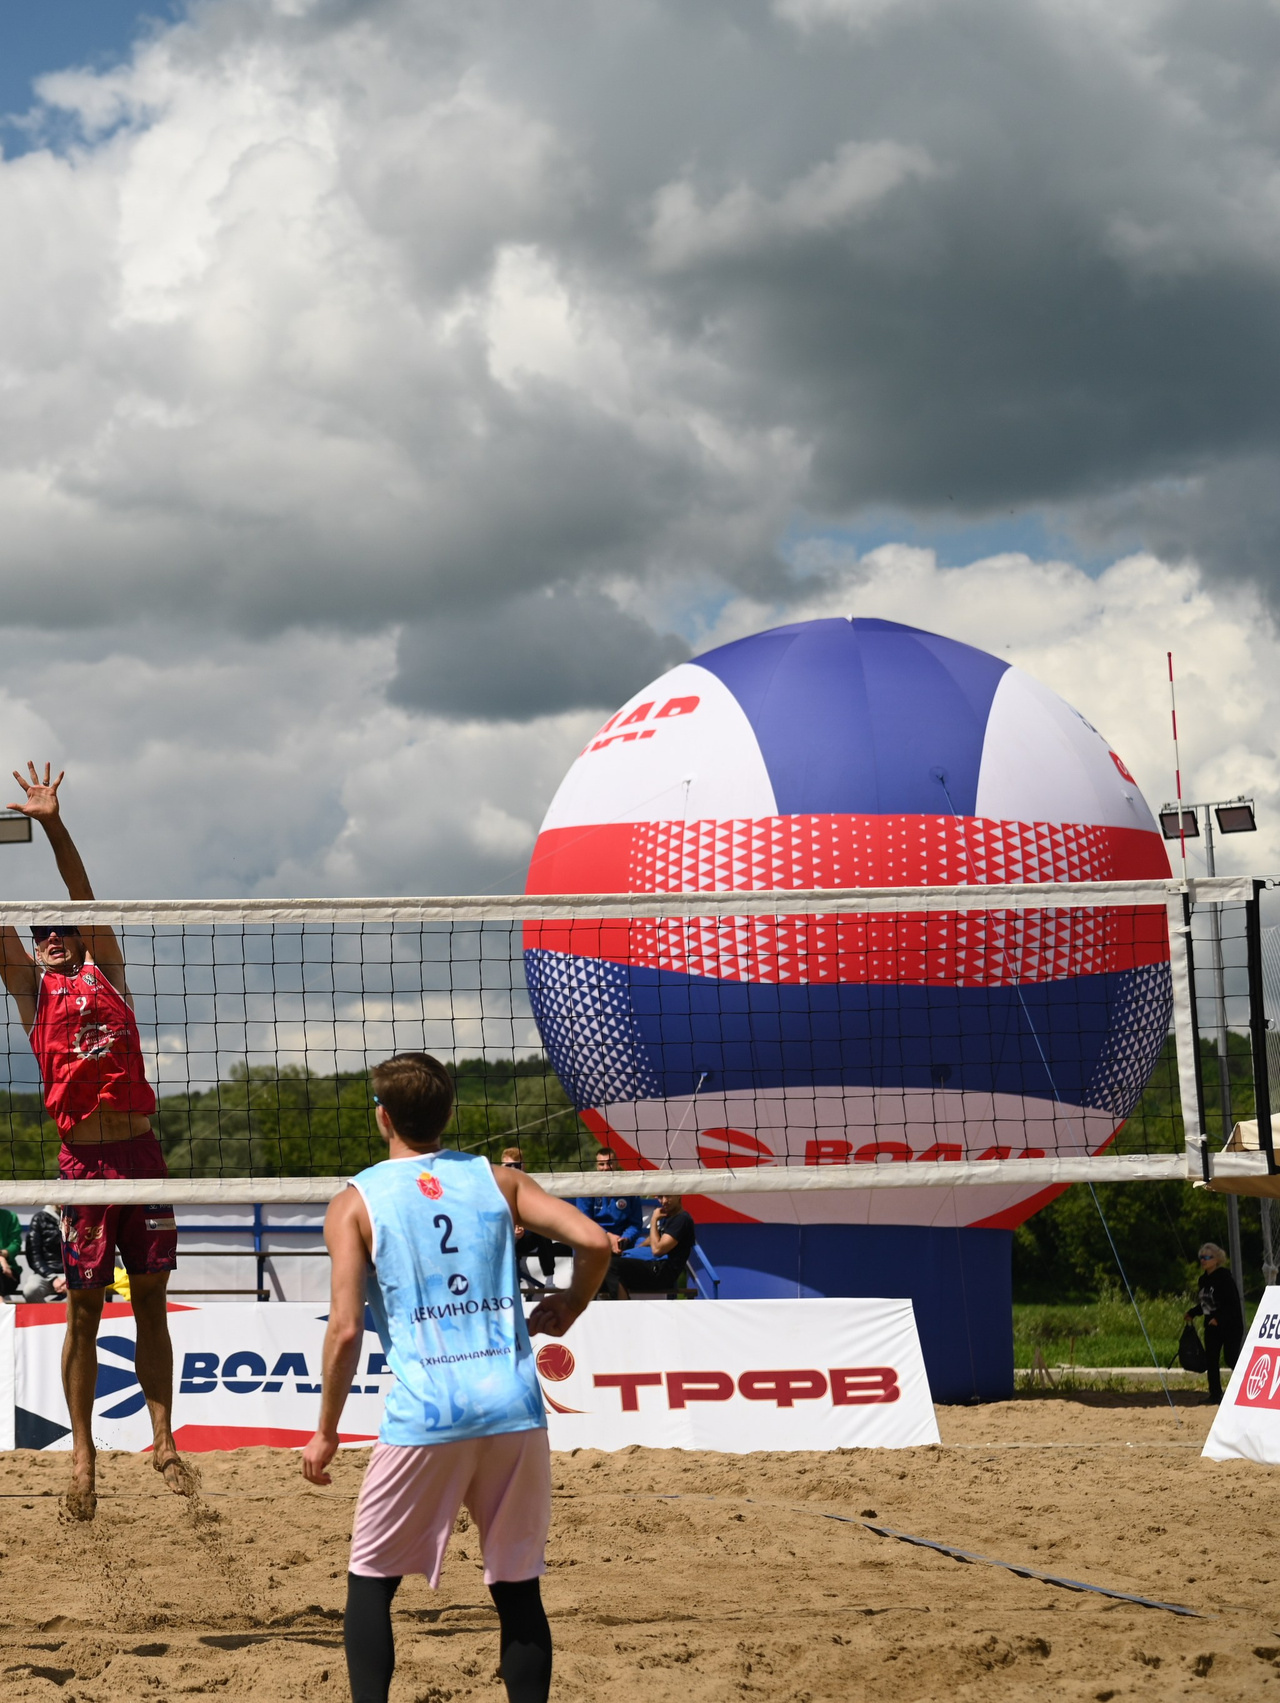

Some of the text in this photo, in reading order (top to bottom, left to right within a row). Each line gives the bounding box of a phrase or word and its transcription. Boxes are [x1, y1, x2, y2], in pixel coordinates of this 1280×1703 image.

[75, 996, 92, 1016] 2
[433, 1214, 459, 1254] 2
[592, 1366, 902, 1412] ТРФВ
